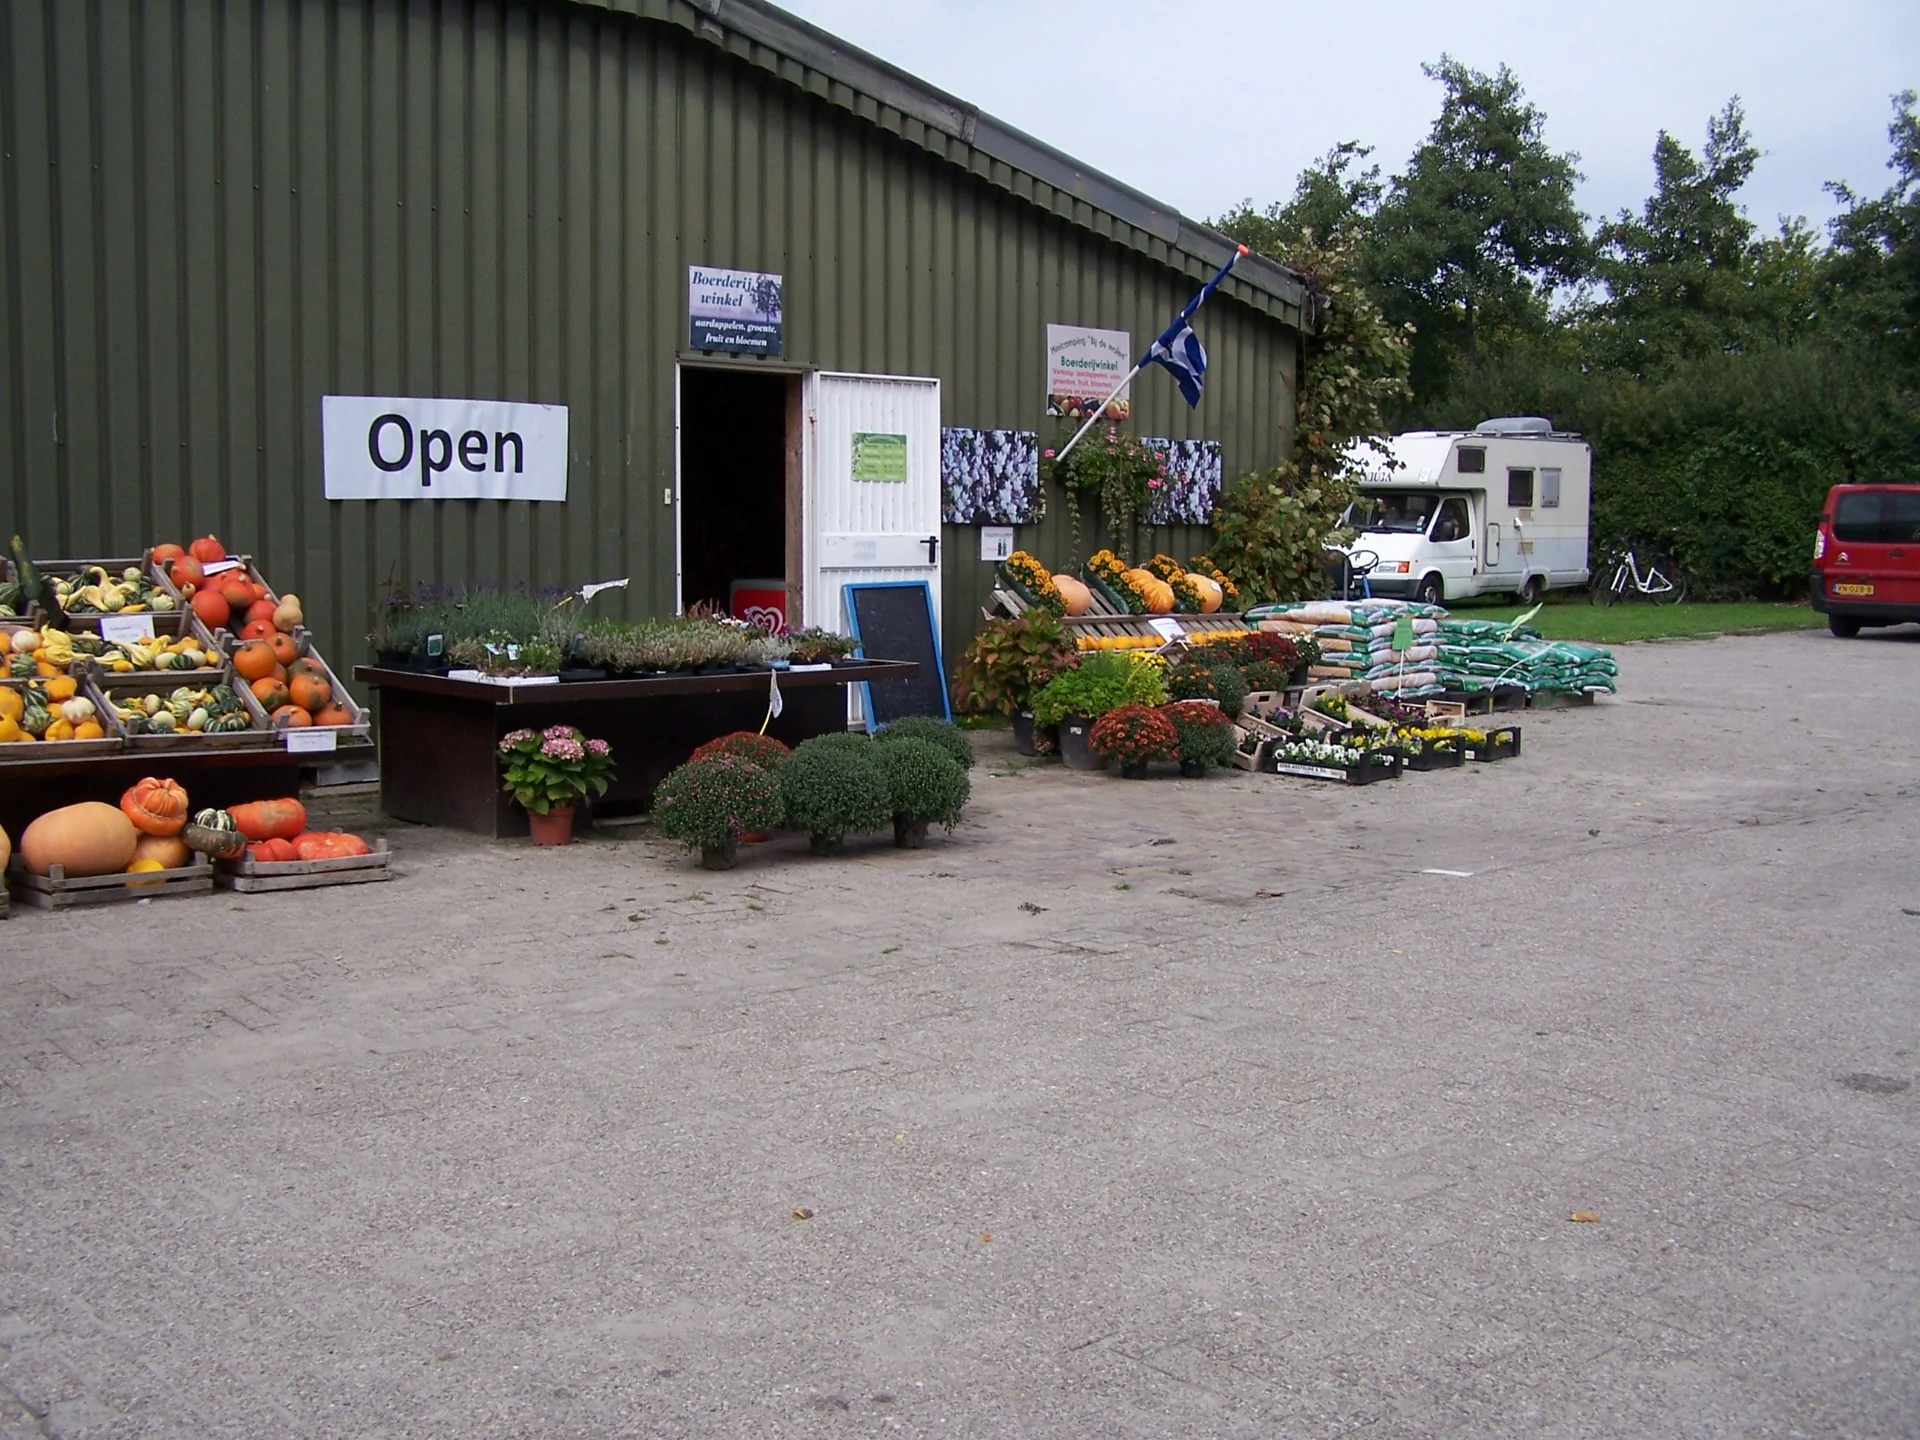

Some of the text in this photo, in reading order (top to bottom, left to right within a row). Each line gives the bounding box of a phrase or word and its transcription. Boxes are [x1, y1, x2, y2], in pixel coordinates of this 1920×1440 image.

[701, 292, 742, 306] winkel
[695, 319, 746, 332] aardappelen,
[705, 333, 767, 347] fruit en bloemen
[1099, 339, 1107, 348] de
[1061, 356, 1118, 371] Boerderijwinkel
[368, 413, 524, 487] Open
